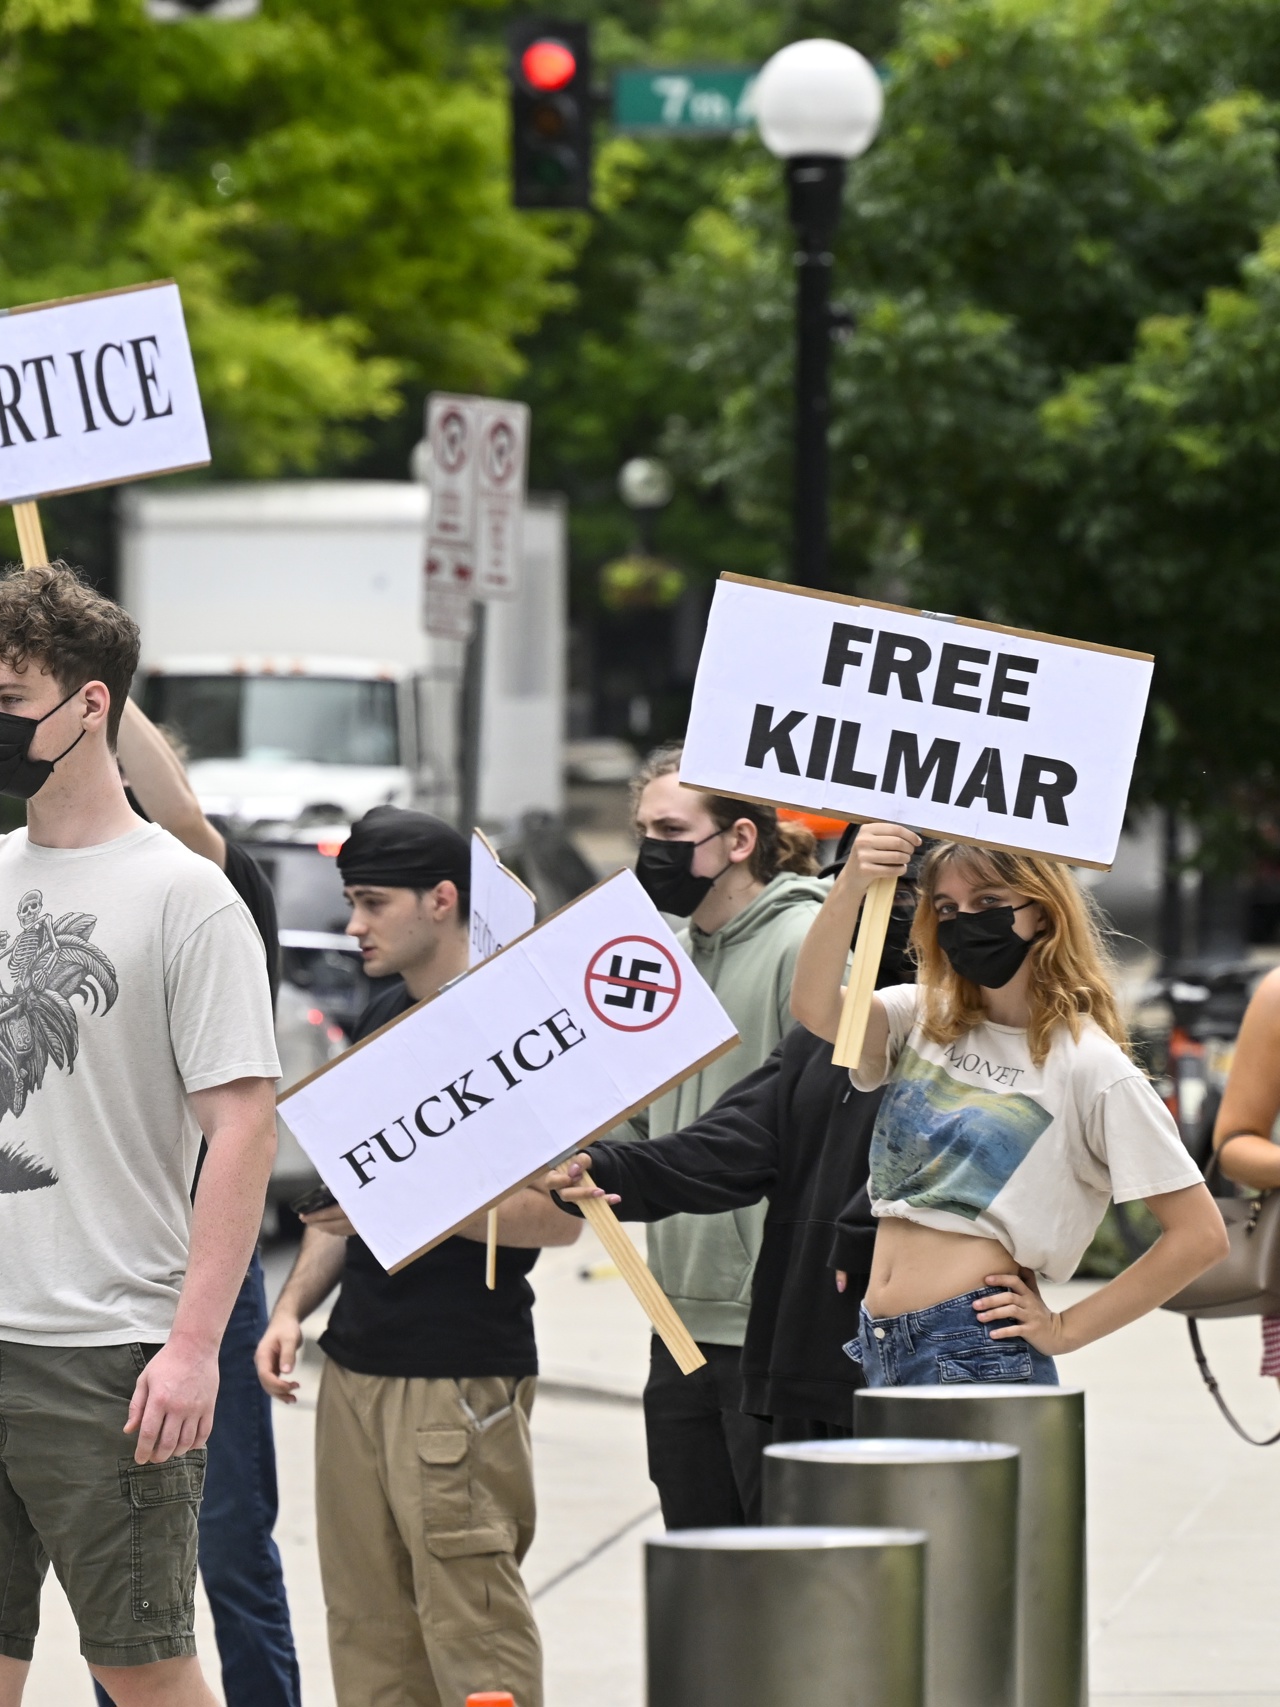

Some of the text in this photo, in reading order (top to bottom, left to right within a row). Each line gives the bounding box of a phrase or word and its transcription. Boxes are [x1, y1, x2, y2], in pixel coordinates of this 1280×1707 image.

[68, 335, 173, 433] ICE
[822, 622, 1039, 722] FREE
[744, 704, 1078, 827] KILMAR
[339, 1008, 587, 1189] FUCK ICE
[943, 1043, 1025, 1087] MONET
